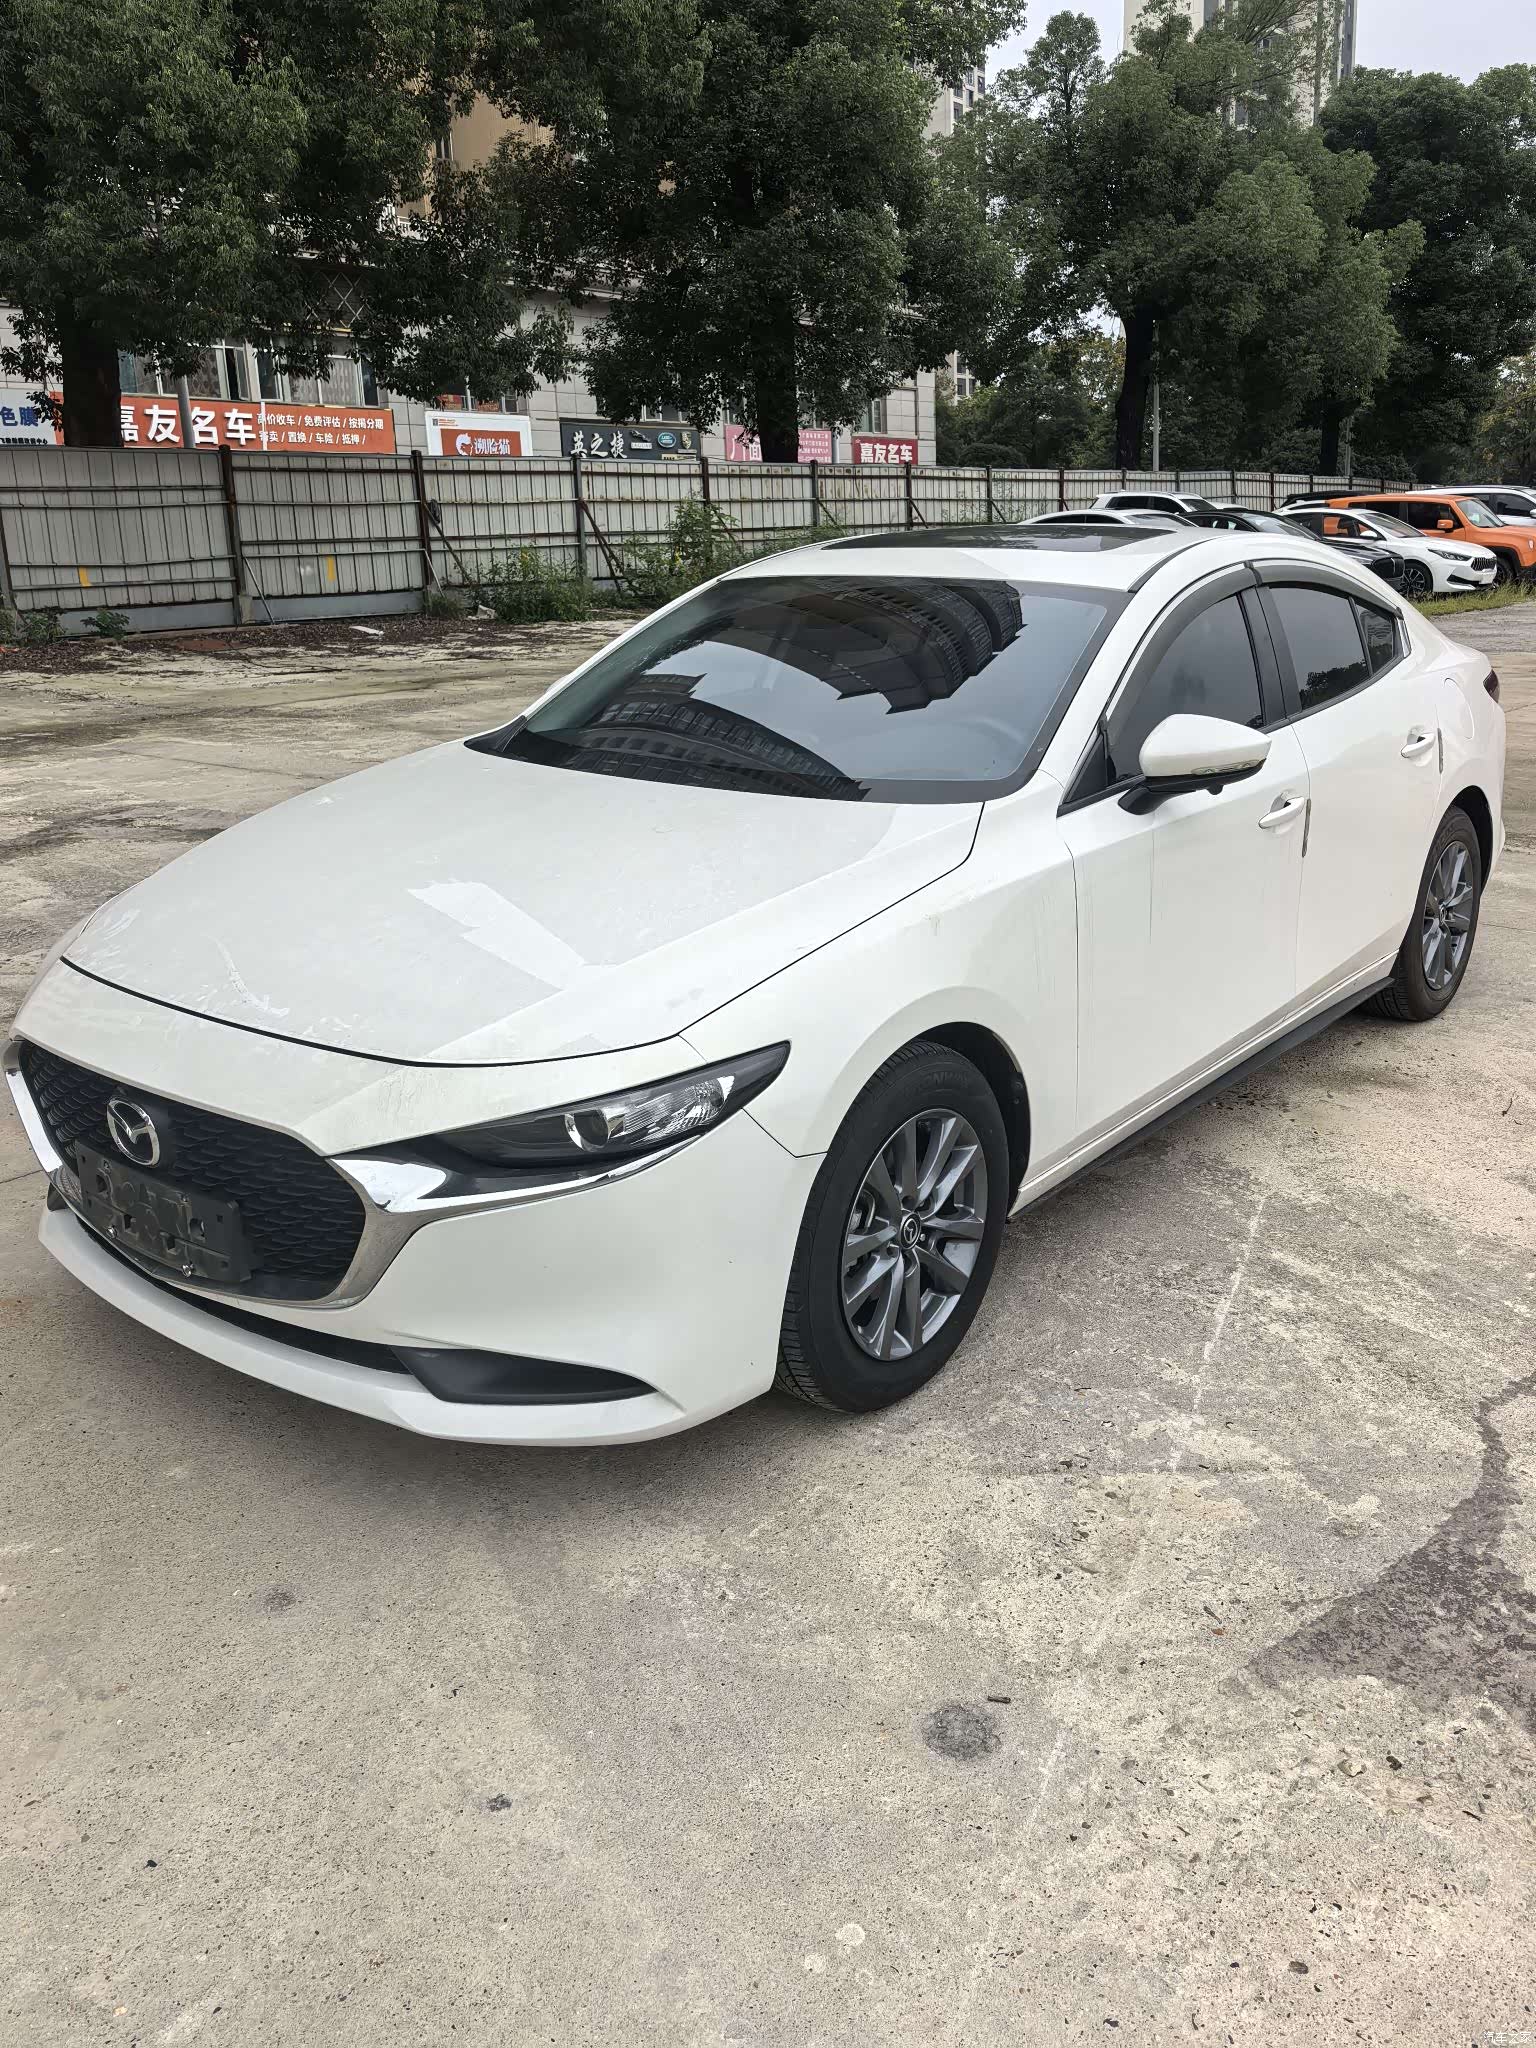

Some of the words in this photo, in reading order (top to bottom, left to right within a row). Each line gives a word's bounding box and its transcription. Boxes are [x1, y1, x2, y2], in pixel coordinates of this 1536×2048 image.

[304, 415, 341, 428] 免费评估
[348, 417, 384, 430] 按揭分期
[287, 432, 307, 443] 置换
[315, 433, 334, 444] 车险
[860, 442, 913, 464] 嘉友名车
